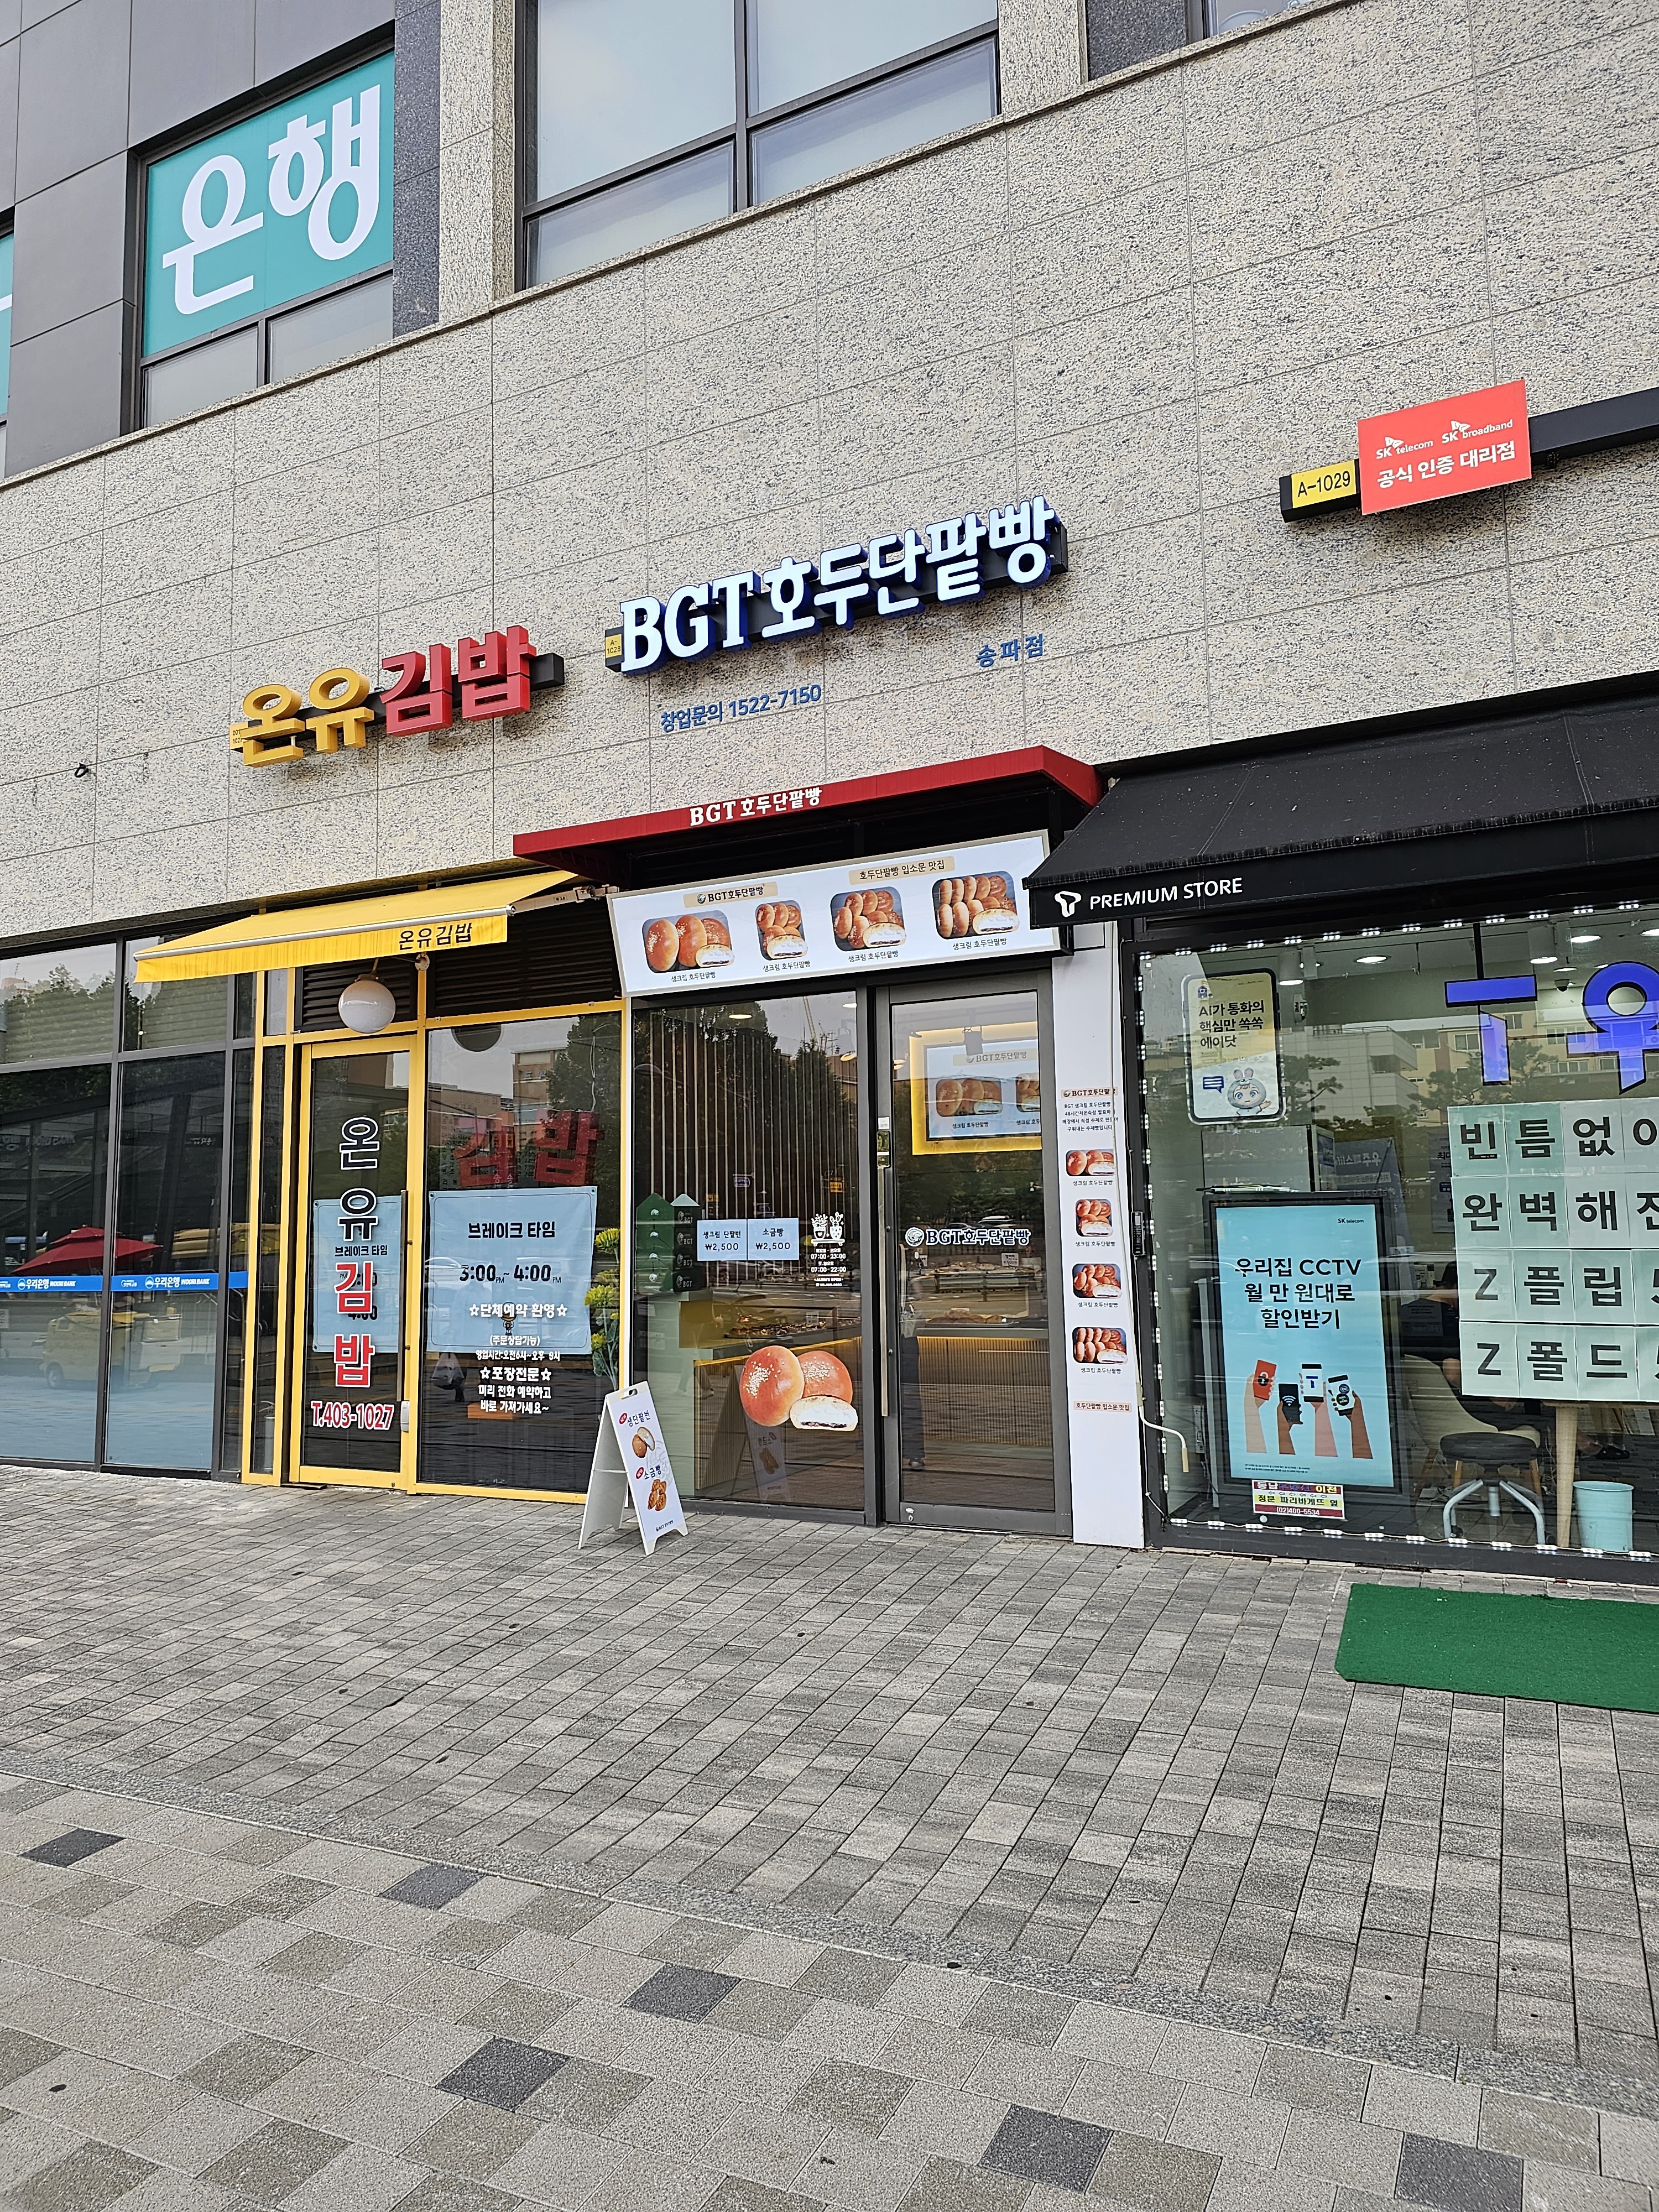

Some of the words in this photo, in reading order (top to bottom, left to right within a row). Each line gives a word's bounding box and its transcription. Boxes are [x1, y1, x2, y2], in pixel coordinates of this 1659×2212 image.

[163, 84, 380, 315] 은행
[1442, 430, 1458, 444] SK
[1462, 419, 1513, 439] broadband
[1376, 446, 1392, 460] SK
[1396, 440, 1433, 455] telecom
[1377, 466, 1413, 489] 공식
[1417, 455, 1455, 480] 인증
[1460, 440, 1516, 468] 대리점
[1297, 470, 1350, 498] A-1029
[620, 570, 761, 675] BGT
[761, 495, 1058, 640] 호두단팥빵
[660, 701, 723, 732] 창업문의
[728, 684, 821, 717] 1522-7150
[740, 787, 822, 817] 호두단팥빵
[859, 866, 899, 880] 호두단팥빵
[901, 862, 926, 875] 입소문
[929, 859, 945, 871] 맛집
[1090, 885, 1177, 910] PREMIUM
[1183, 877, 1243, 899] STORE
[399, 922, 473, 951] 온유김밥
[952, 941, 972, 951] 생크림
[974, 938, 1007, 948] 호두단팥빵
[848, 953, 866, 963] 생크림
[868, 950, 899, 959] 호두단팥빵
[763, 963, 780, 972] 생크림
[781, 961, 810, 970] 호두단팥빵
[688, 972, 716, 980] 호두단팥빵
[1199, 1003, 1225, 1016] AI가
[1227, 1000, 1264, 1015] 통화의
[1199, 1019, 1236, 1033] 핵심만
[1239, 1016, 1264, 1030] 쏙쏙
[1200, 1035, 1237, 1049] 에이닷
[468, 1222, 523, 1239] 브레이크
[528, 1221, 555, 1238] 타임
[703, 1230, 720, 1239] 생크림
[762, 1228, 784, 1237] 소금빵
[335, 1245, 369, 1257] 브레이크
[372, 1245, 388, 1256] 타임
[514, 1264, 551, 1282] 4:00
[1235, 1258, 1292, 1277] 우리집
[1299, 1259, 1361, 1275] CCTV
[26, 1279, 49, 1289] 우리은행
[154, 1277, 180, 1287] 우리은행
[1244, 1283, 1263, 1302] 월
[1270, 1283, 1288, 1302] 만
[1295, 1283, 1355, 1303] 원대로
[1260, 1308, 1340, 1329] 할인받기
[489, 1335, 540, 1346] (주문상담가능)
[549, 1351, 560, 1361] 9시
[478, 1385, 495, 1397] 미리
[498, 1385, 515, 1398] 전화
[517, 1386, 551, 1399] 예약하고
[481, 1400, 497, 1412] 바로
[311, 1400, 395, 1431] T.403-1027
[644, 1464, 662, 1480] 소금빵
[1316, 1485, 1337, 1494] 이전
[1258, 1495, 1275, 1503] 정문
[1280, 1496, 1324, 1506] 파리바게뜨
